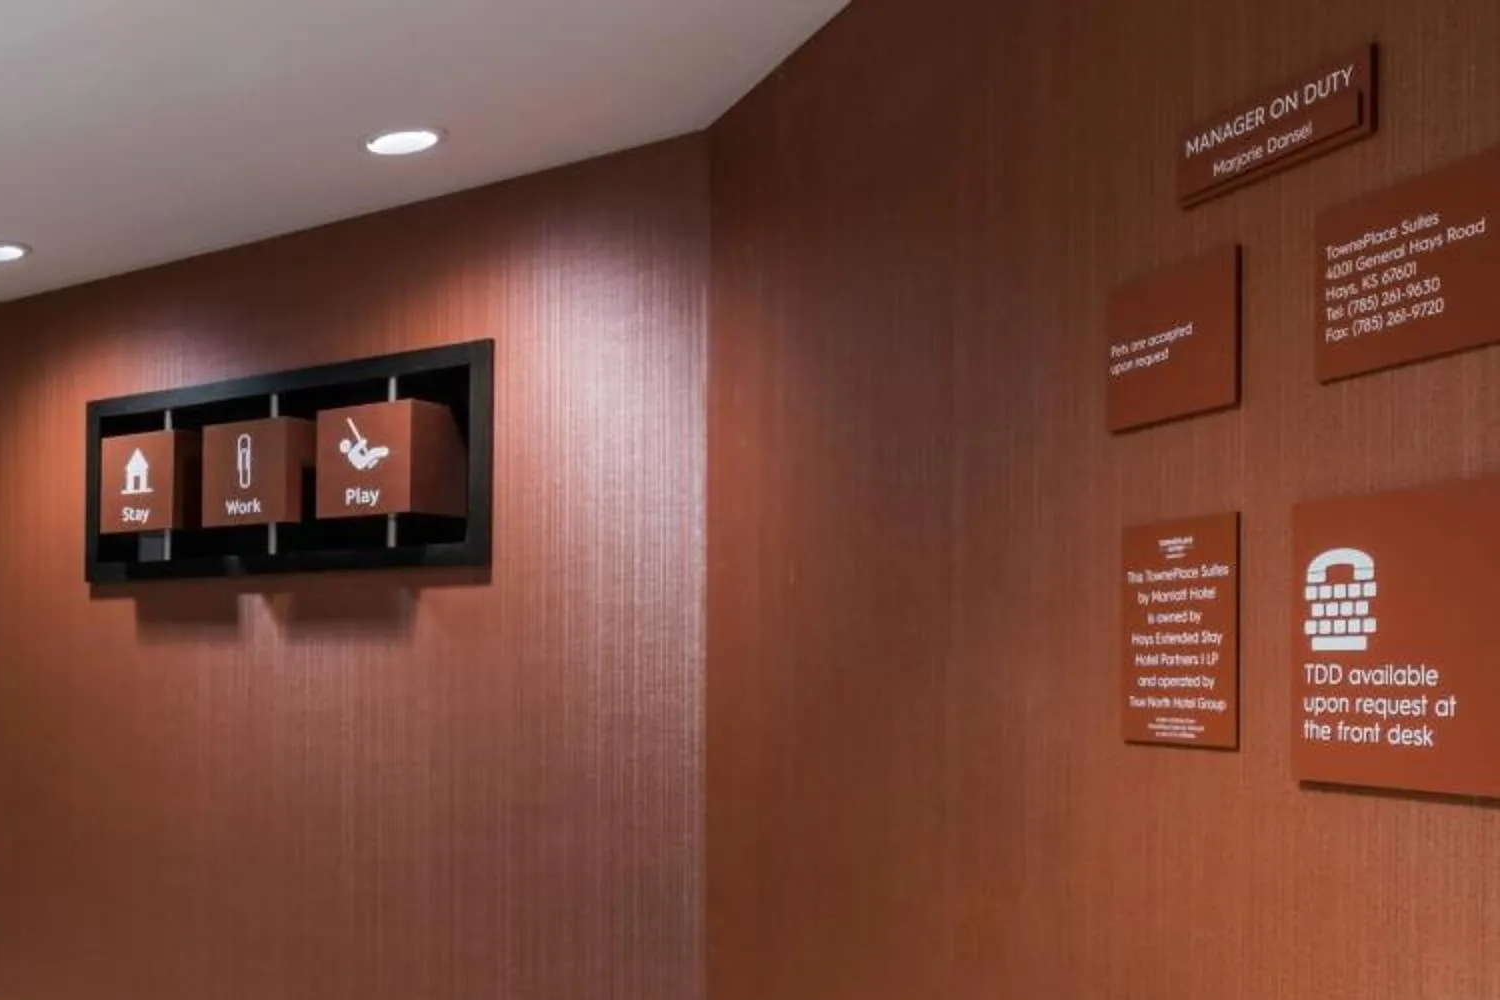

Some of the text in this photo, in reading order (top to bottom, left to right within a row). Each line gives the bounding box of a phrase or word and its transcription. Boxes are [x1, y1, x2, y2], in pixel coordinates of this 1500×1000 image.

[1185, 64, 1354, 159] MANAGER ON DUTY
[1213, 144, 1264, 177] Marjorie
[1325, 212, 1440, 260] TownePlace Suites
[1326, 217, 1486, 280] 4001 General Hays Road
[1361, 273, 1379, 291] KS
[1381, 261, 1417, 285] 67601
[1347, 295, 1379, 317] (785)
[1381, 277, 1441, 307] 261-9630
[1352, 314, 1383, 337] (785)
[1386, 297, 1445, 327] 261-9720
[1130, 339, 1147, 352] are
[1147, 321, 1193, 346] accepted
[1110, 347, 1169, 376] upon request
[225, 499, 261, 515] Work
[345, 488, 380, 507] Play
[121, 506, 150, 524] Stay
[1201, 563, 1229, 577] Suites
[1137, 591, 1150, 606] by
[1189, 586, 1217, 600] Hotel
[1155, 611, 1188, 624] owned
[1189, 610, 1202, 624] by
[1131, 630, 1223, 648] Hays Extended Stay
[1135, 653, 1159, 666] Hotel
[1161, 652, 1199, 665] Partners
[1137, 675, 1215, 690] and operated by
[1304, 663, 1439, 687] TDD available
[1173, 697, 1197, 709] Hotel
[1198, 697, 1228, 712] Group
[1303, 695, 1457, 720] upon request at
[1304, 719, 1434, 746] the front desk
